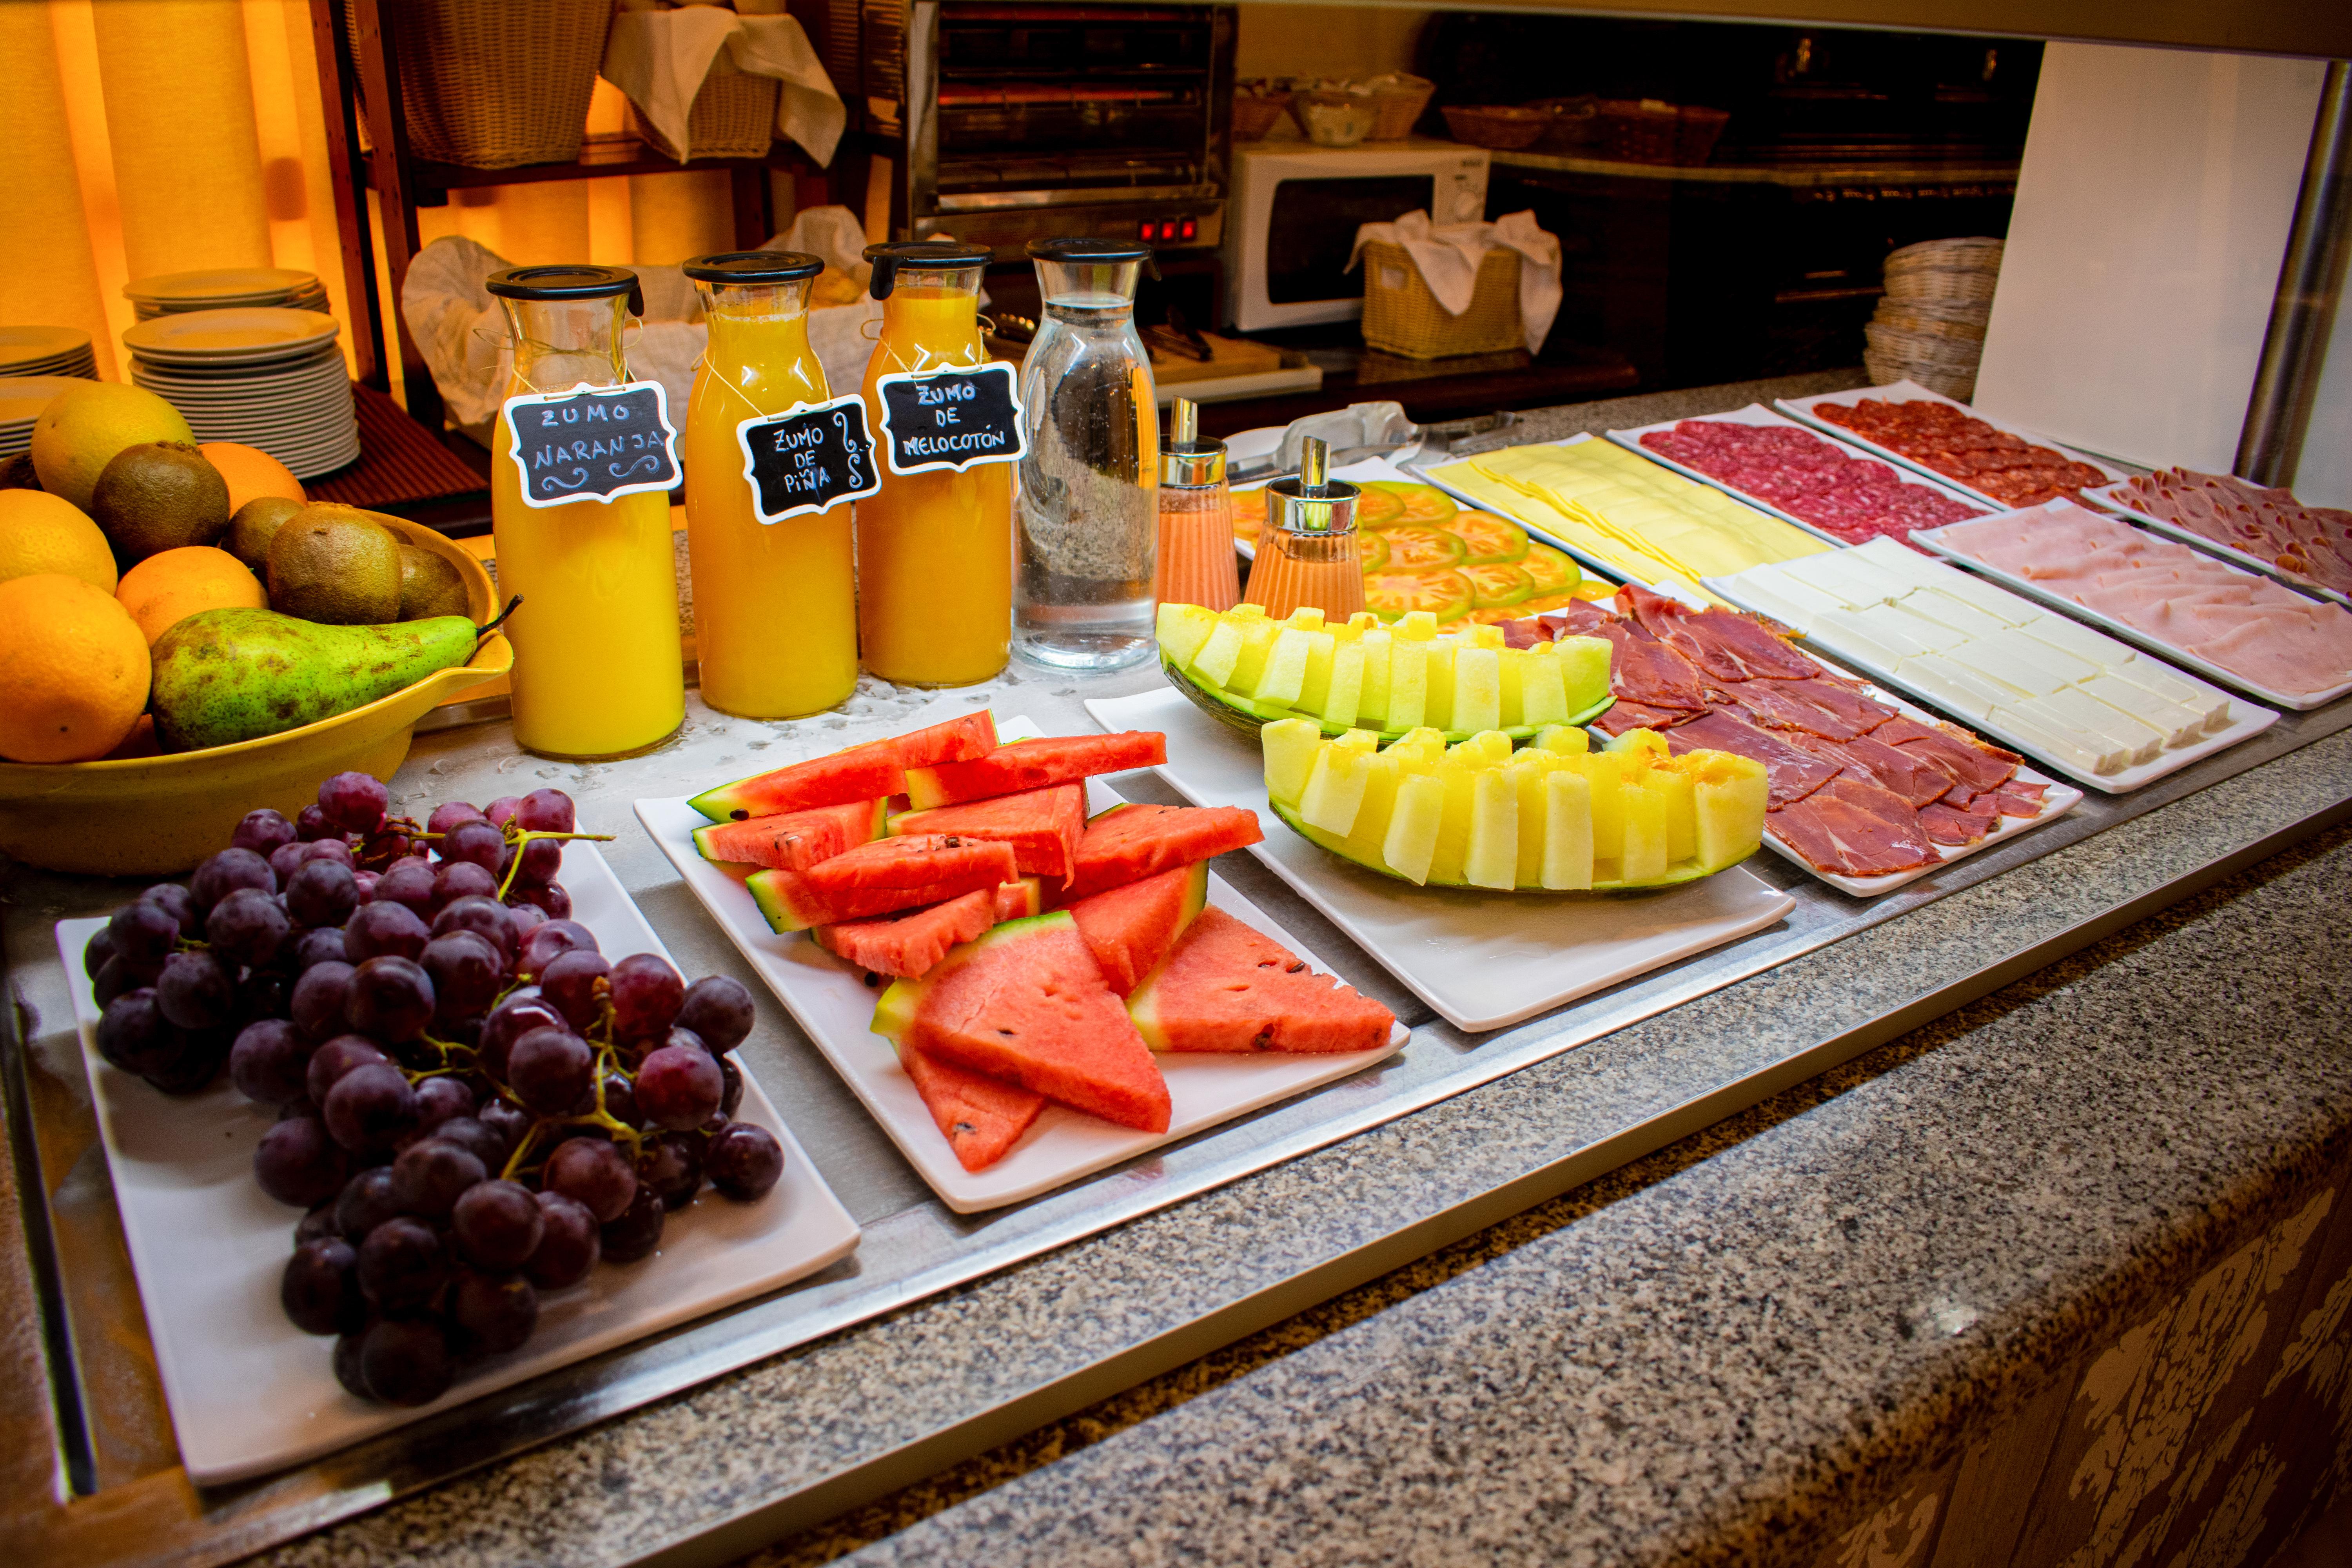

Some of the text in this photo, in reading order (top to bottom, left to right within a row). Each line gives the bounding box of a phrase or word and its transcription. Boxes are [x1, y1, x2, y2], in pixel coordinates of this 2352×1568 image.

[916, 383, 976, 405] ZUMO
[542, 404, 630, 427] ZUMO
[935, 407, 960, 427] DE
[534, 431, 665, 470] NARANJA
[773, 427, 824, 452] ZUMO
[903, 424, 1005, 456] MELOCOTÓN
[794, 450, 816, 469] DE
